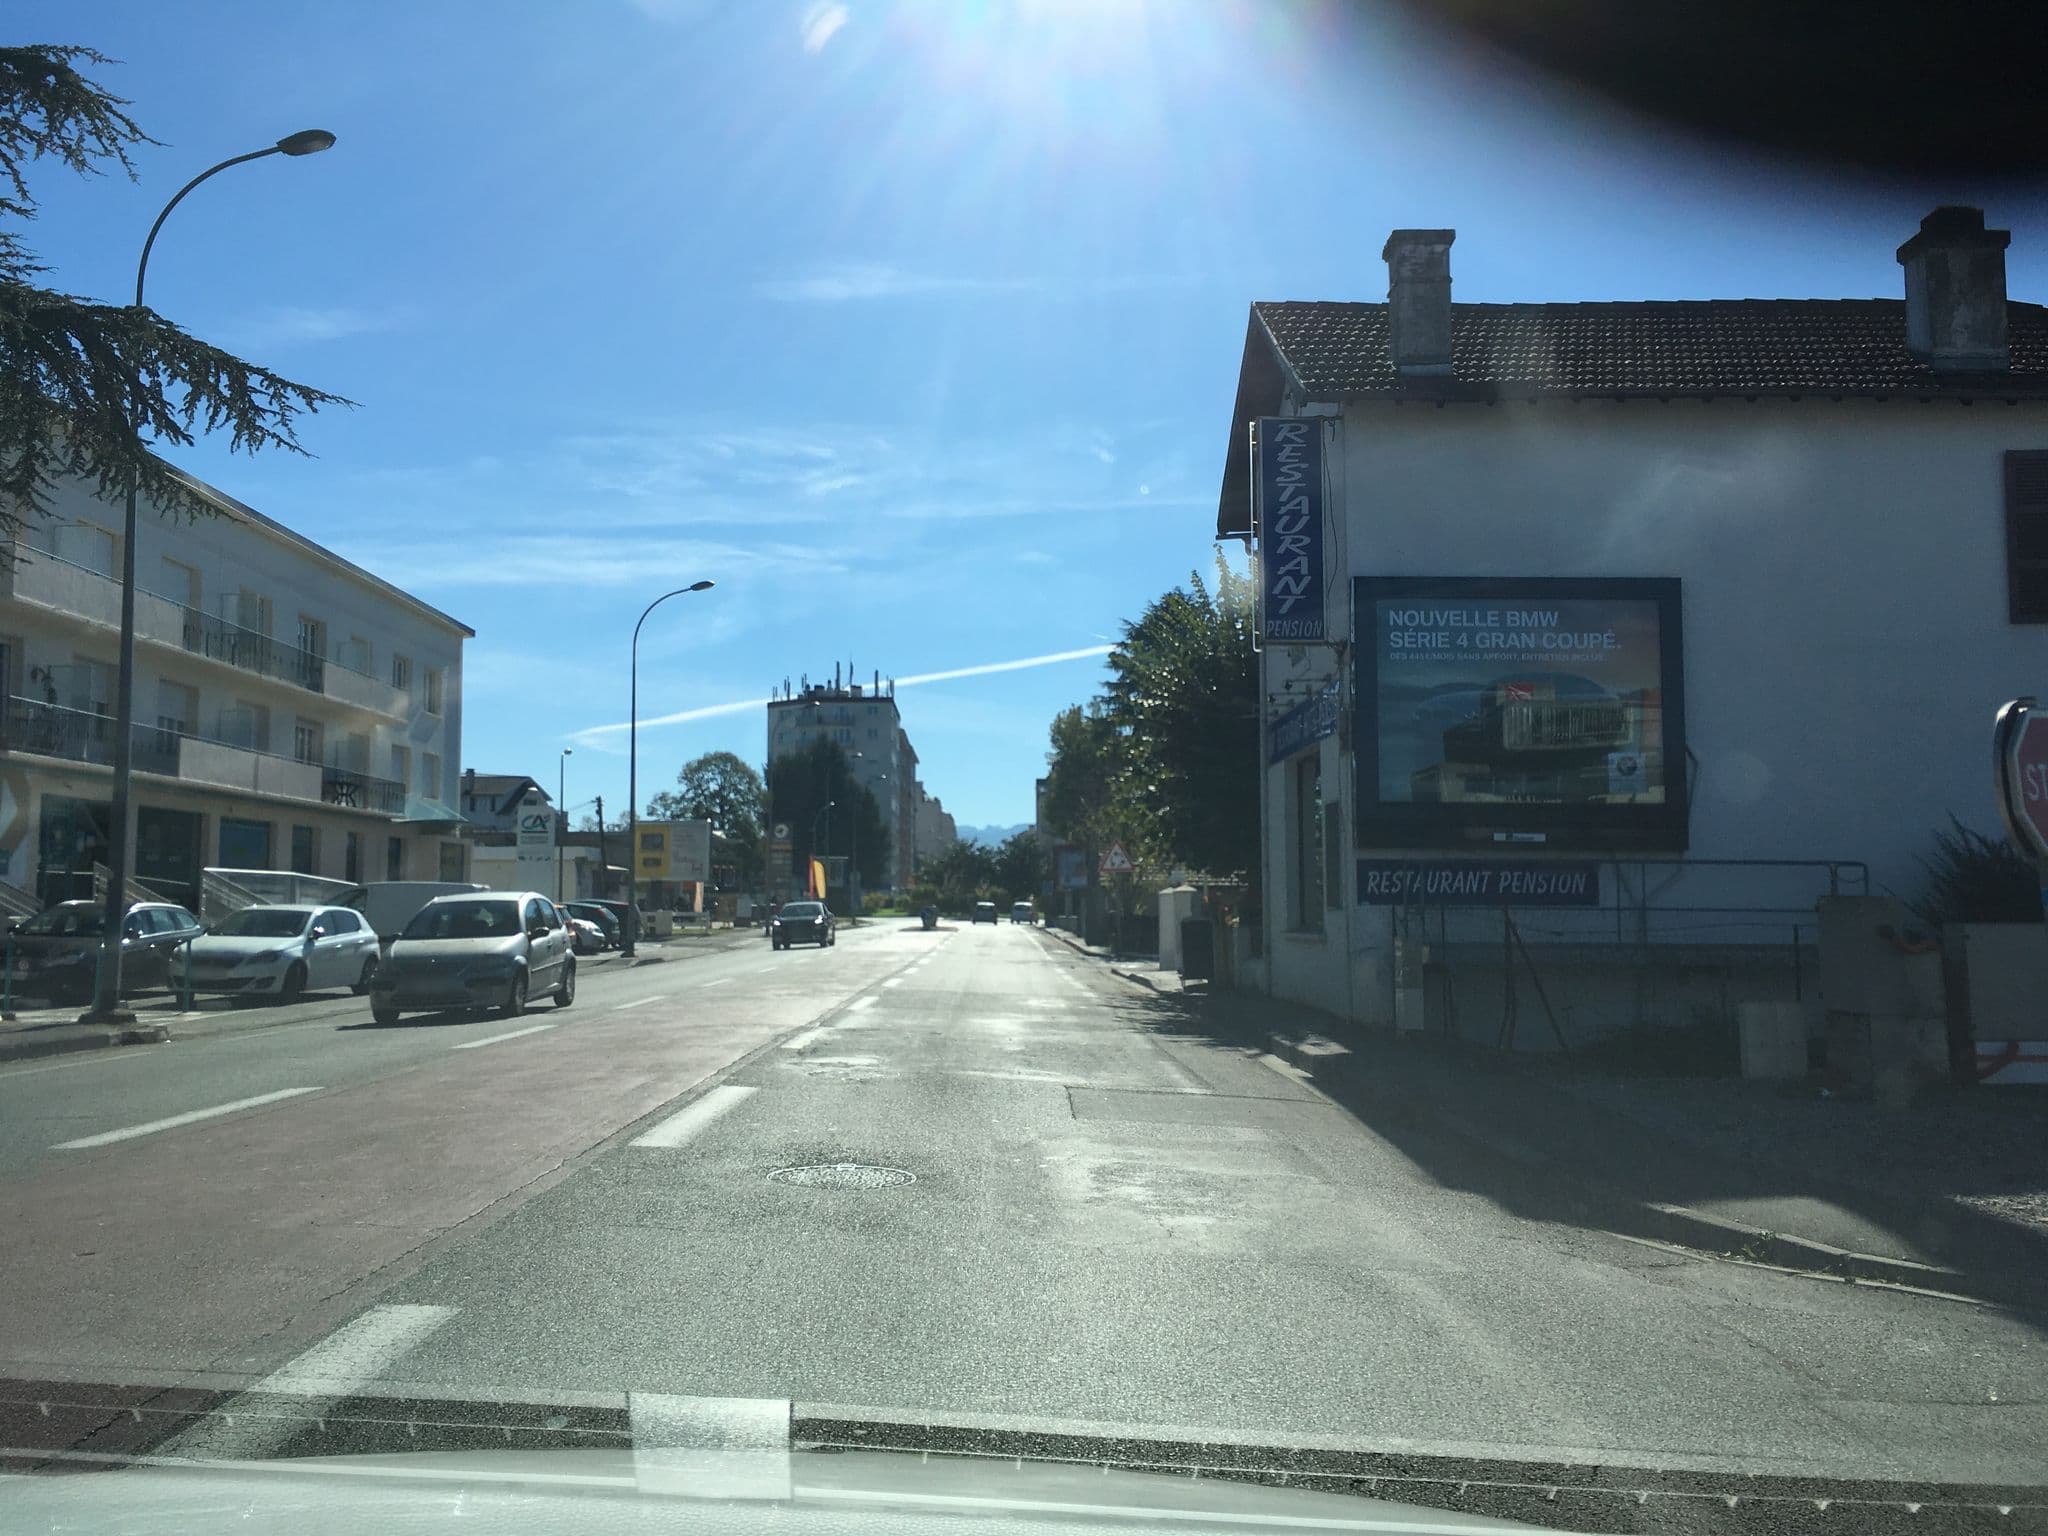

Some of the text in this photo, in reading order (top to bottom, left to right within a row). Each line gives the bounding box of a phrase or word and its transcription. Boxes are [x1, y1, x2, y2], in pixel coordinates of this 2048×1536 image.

[1272, 422, 1312, 615] RESTAURANT
[1265, 618, 1323, 638] PENSION
[1389, 610, 1560, 628] NOUVELLE BMW
[1389, 628, 1622, 649] SÉRIE 4 GRAN COUPÉ.
[1367, 870, 1587, 895] RESTAURANT PENSION
